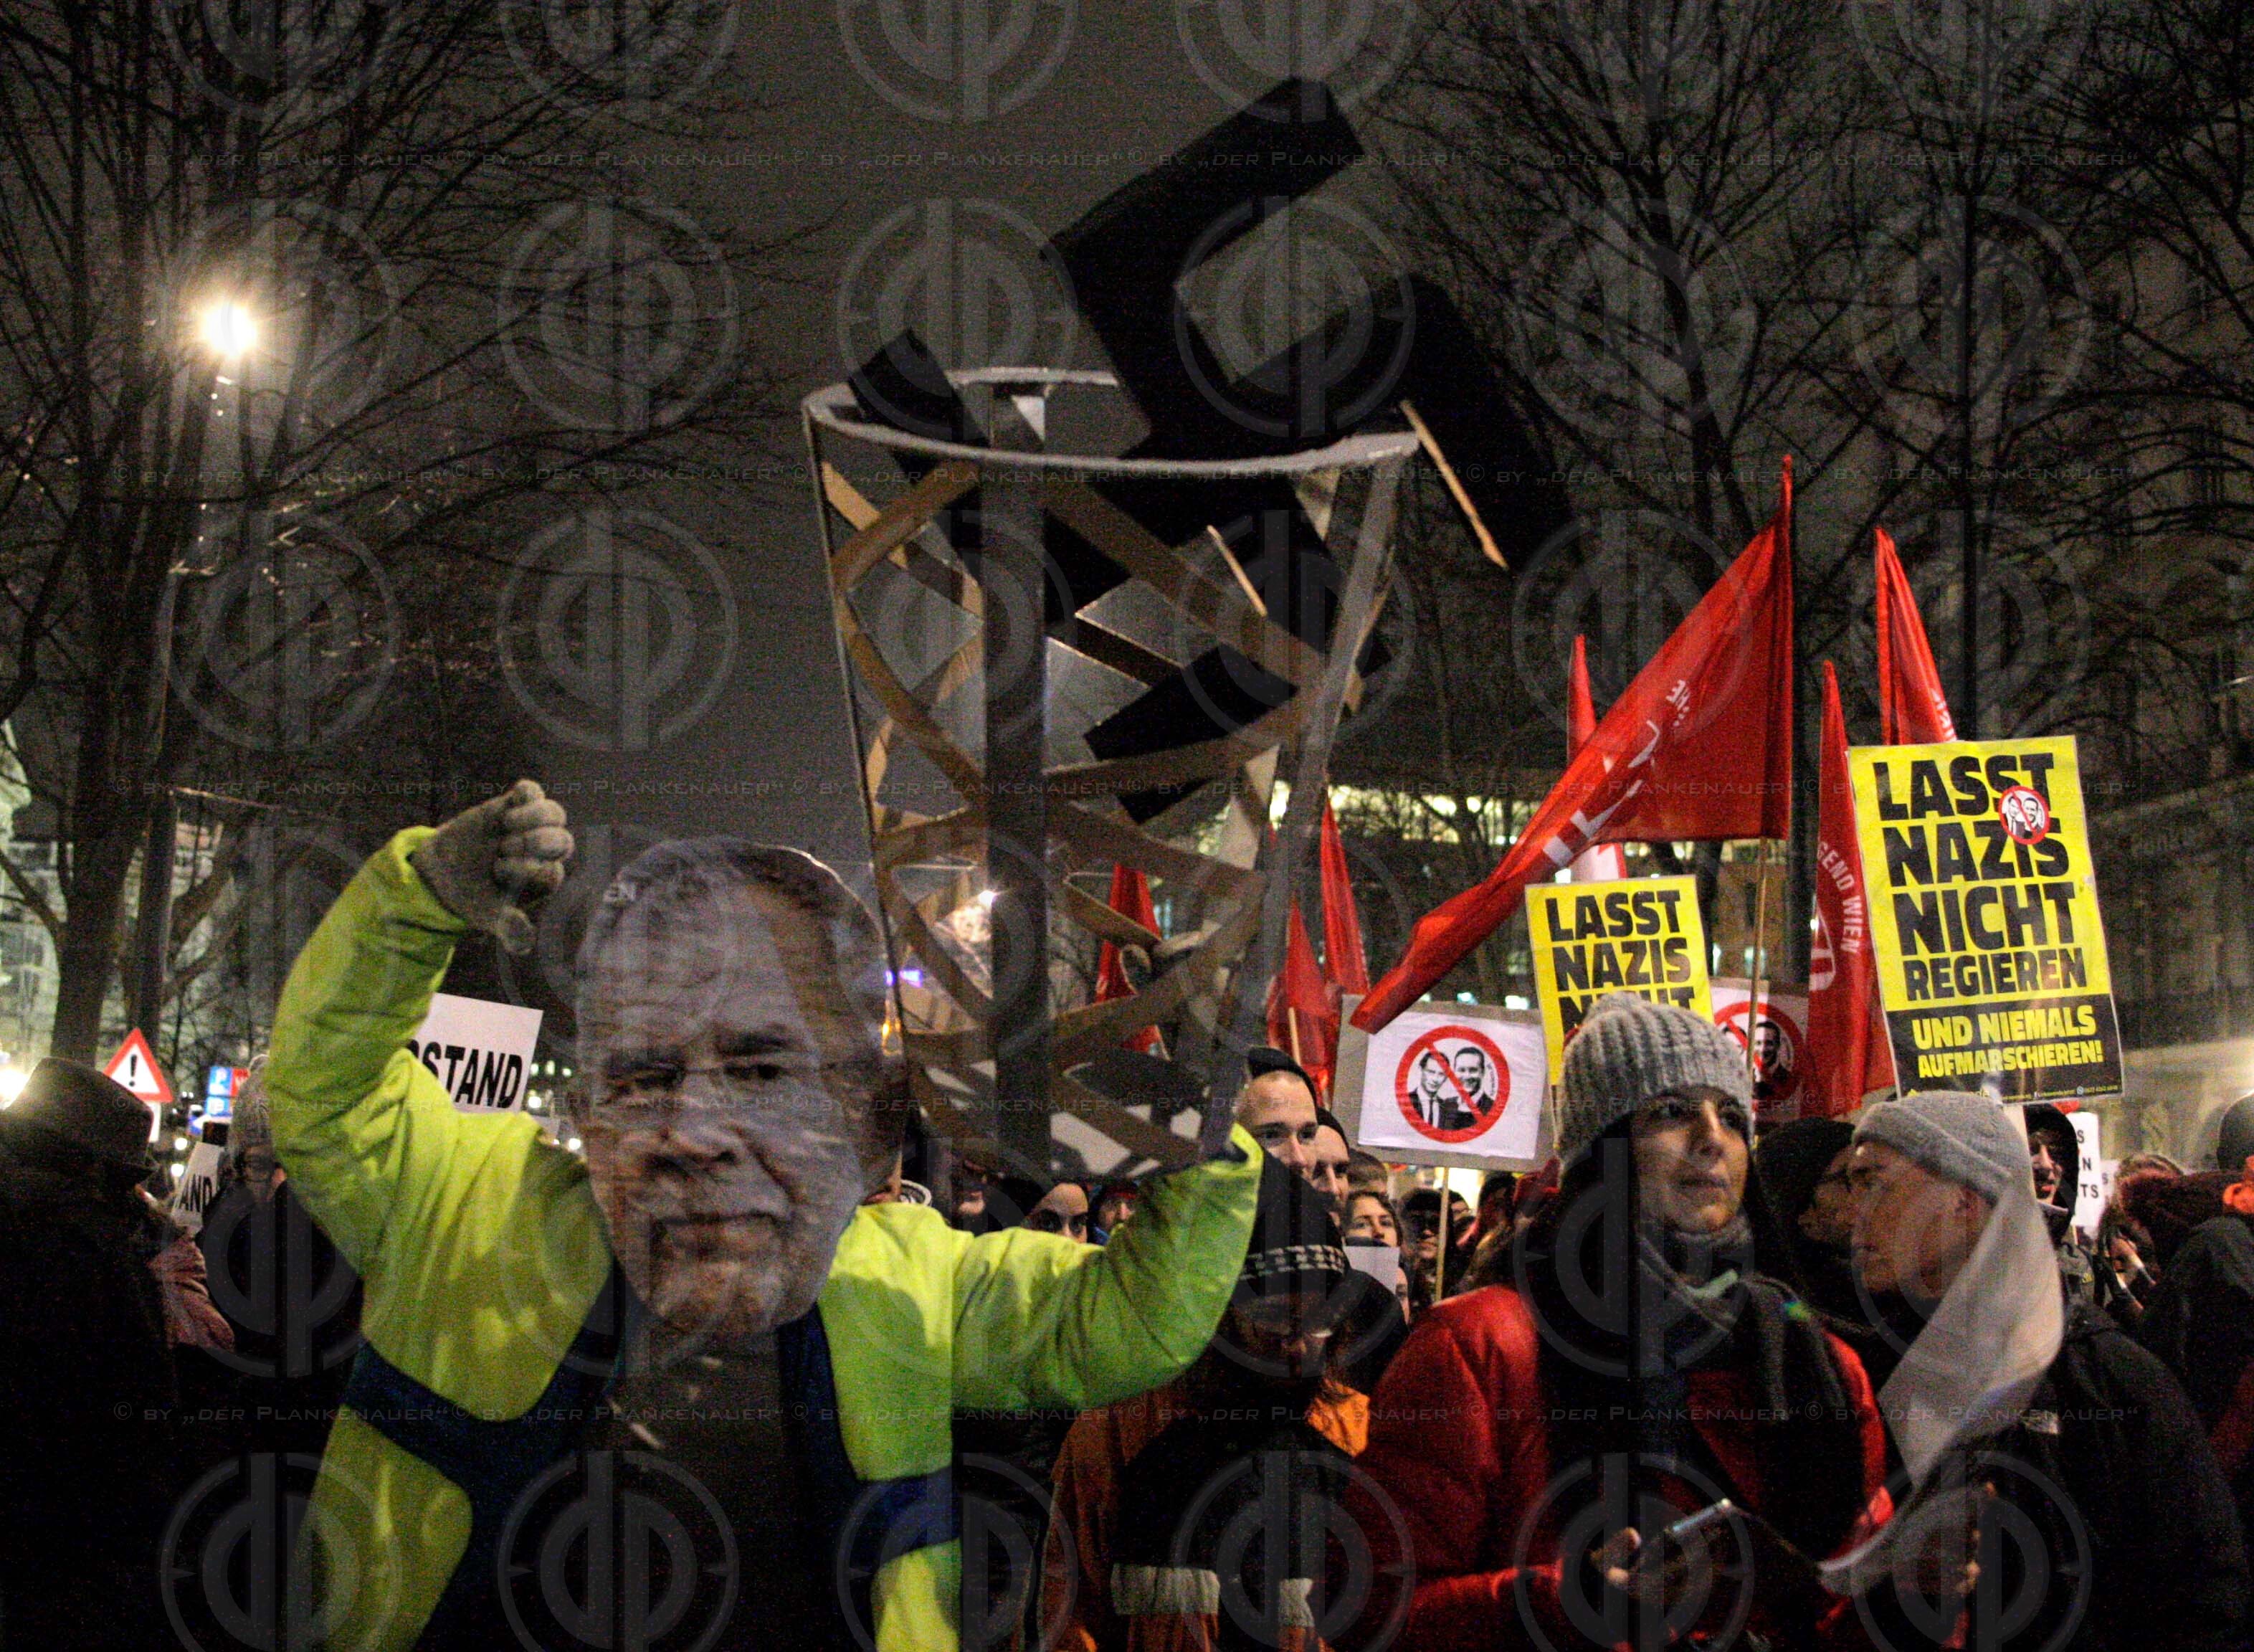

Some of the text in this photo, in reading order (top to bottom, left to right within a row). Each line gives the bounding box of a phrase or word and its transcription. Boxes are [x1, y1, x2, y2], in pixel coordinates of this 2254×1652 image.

[1873, 752, 2054, 821] LASST
[1883, 820, 2069, 887] NAZIS
[1545, 890, 1681, 941] LASST
[1840, 895, 1863, 954] WIEN
[1893, 882, 2075, 956] NICHT
[1551, 937, 1692, 992] NAZIS
[1903, 948, 2086, 1001] REGIEREN
[1912, 1005, 2097, 1050] UND NIEMALS
[1918, 1040, 2103, 1078] AUFMARSCHIEREN!
